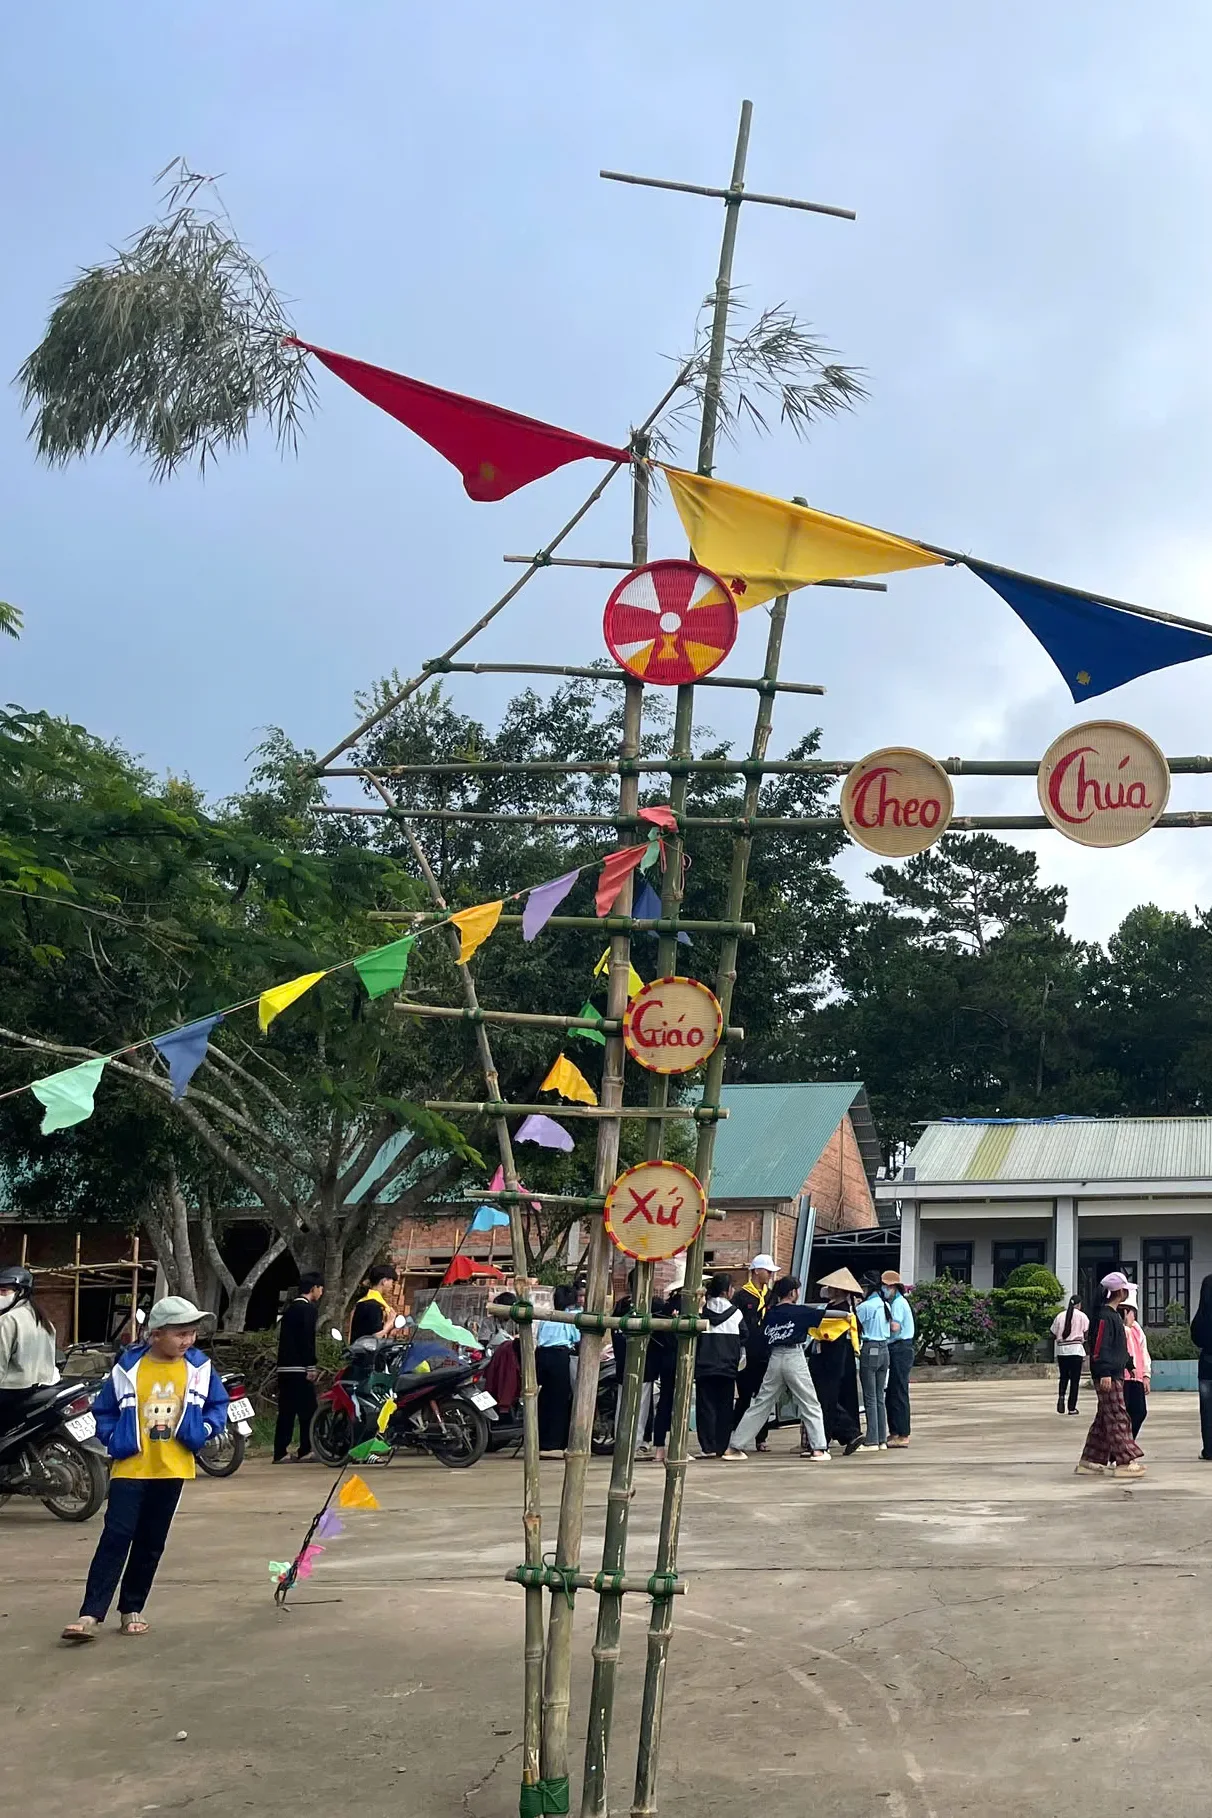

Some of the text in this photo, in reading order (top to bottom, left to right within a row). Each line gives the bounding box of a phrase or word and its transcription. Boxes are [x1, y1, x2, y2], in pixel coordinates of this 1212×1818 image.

[1048, 747, 1152, 824] Chúa
[631, 1000, 705, 1049] Giáo
[622, 1186, 684, 1229] Xứ
